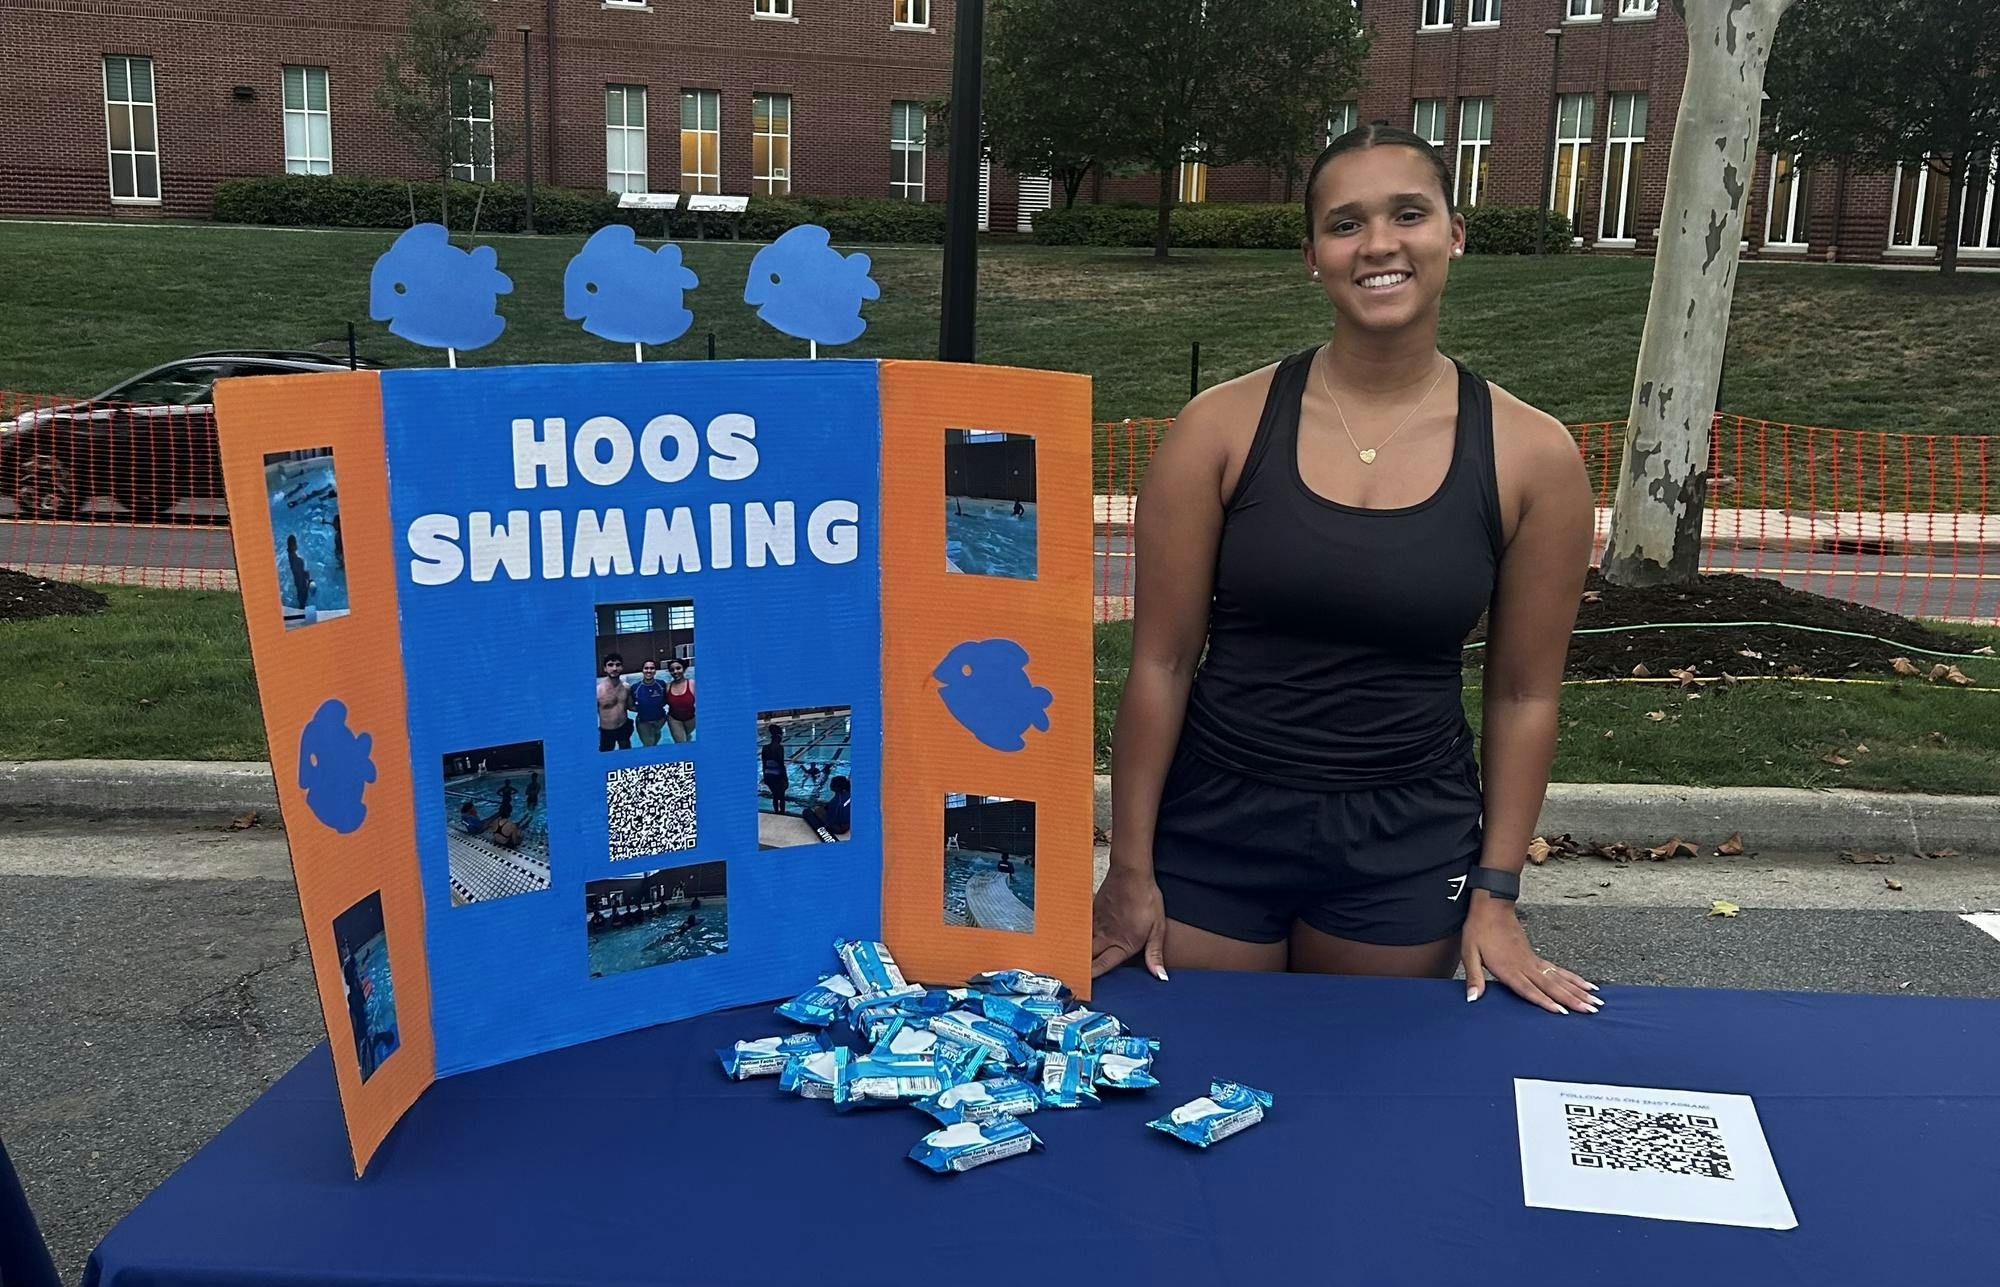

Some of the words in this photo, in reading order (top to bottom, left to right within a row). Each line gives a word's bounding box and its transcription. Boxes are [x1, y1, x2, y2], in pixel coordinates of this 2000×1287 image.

[512, 413, 760, 489] HOOS
[407, 500, 859, 586] SWIMMING
[1560, 1092, 1604, 1101] FOLLOW
